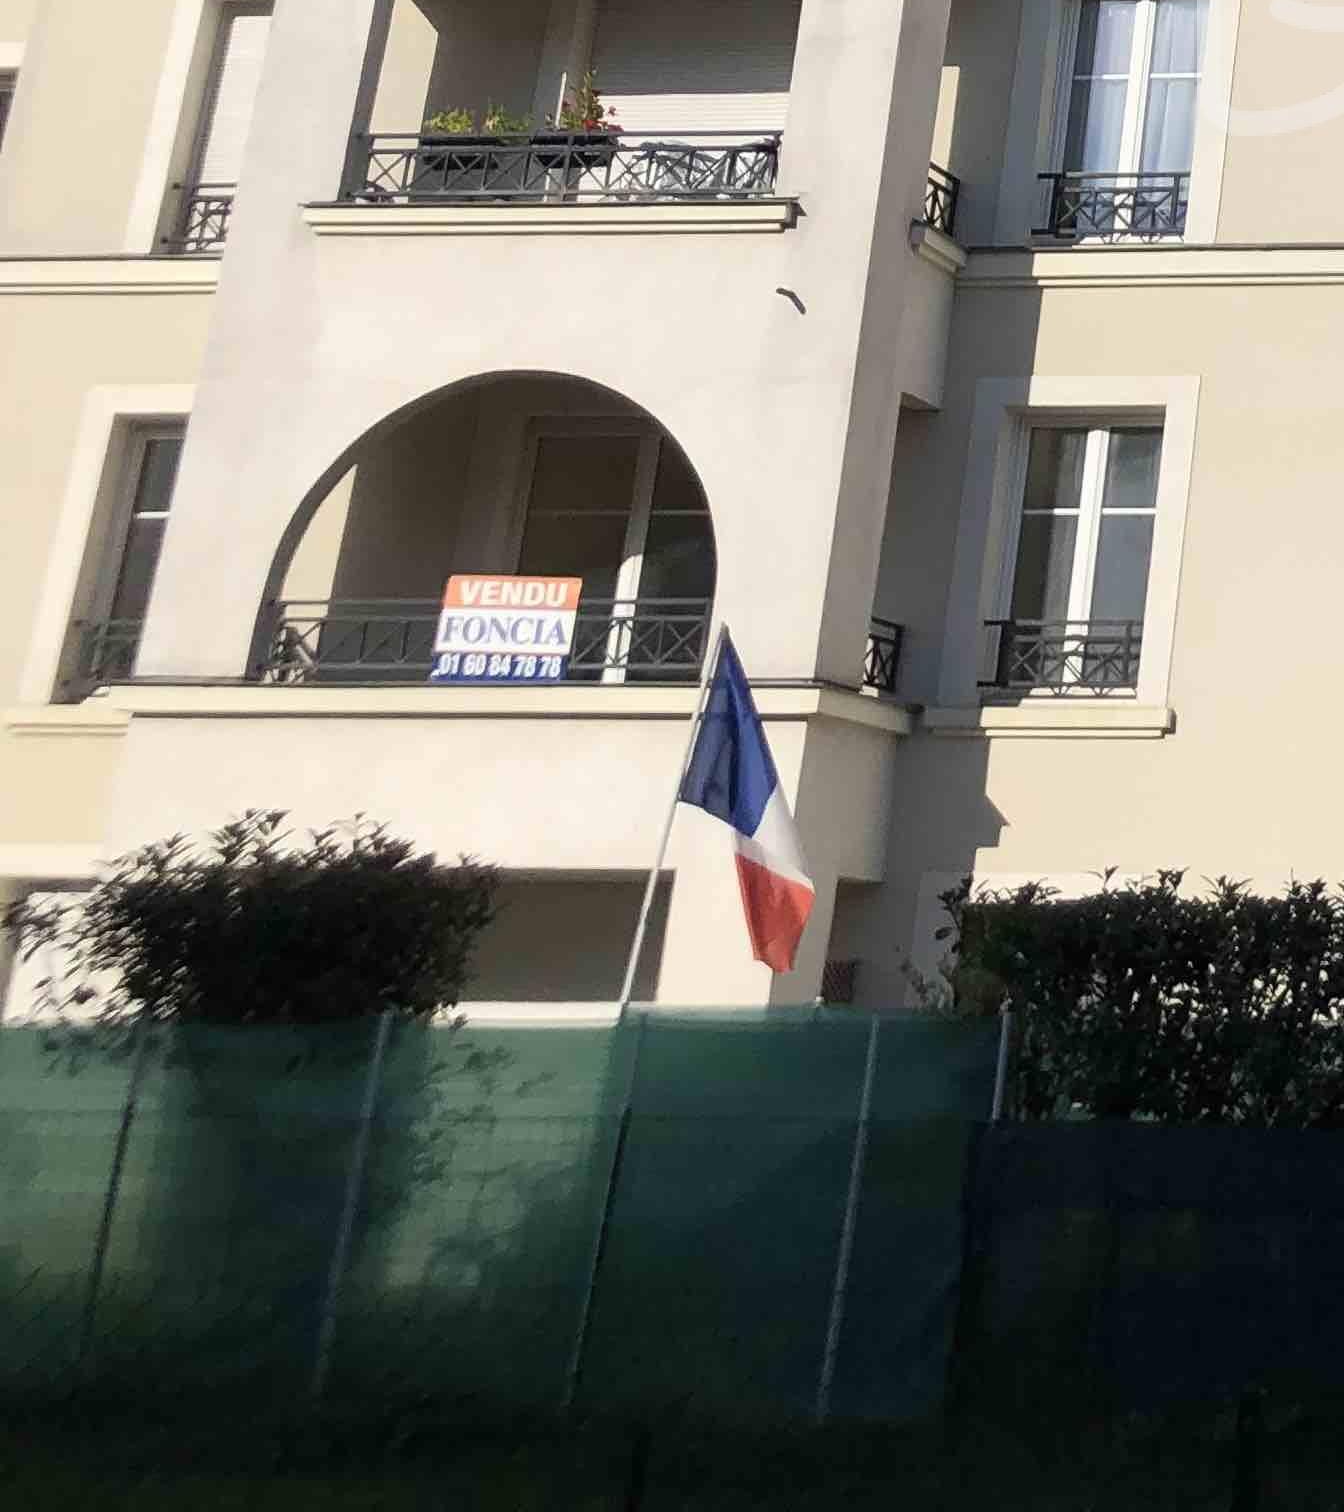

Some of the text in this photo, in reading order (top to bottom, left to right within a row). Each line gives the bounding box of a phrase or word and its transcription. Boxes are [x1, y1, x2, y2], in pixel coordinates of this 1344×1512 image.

[459, 579, 568, 606] VENDU
[441, 615, 568, 644] FONCIA
[439, 653, 460, 674] 01
[463, 653, 486, 675] 60
